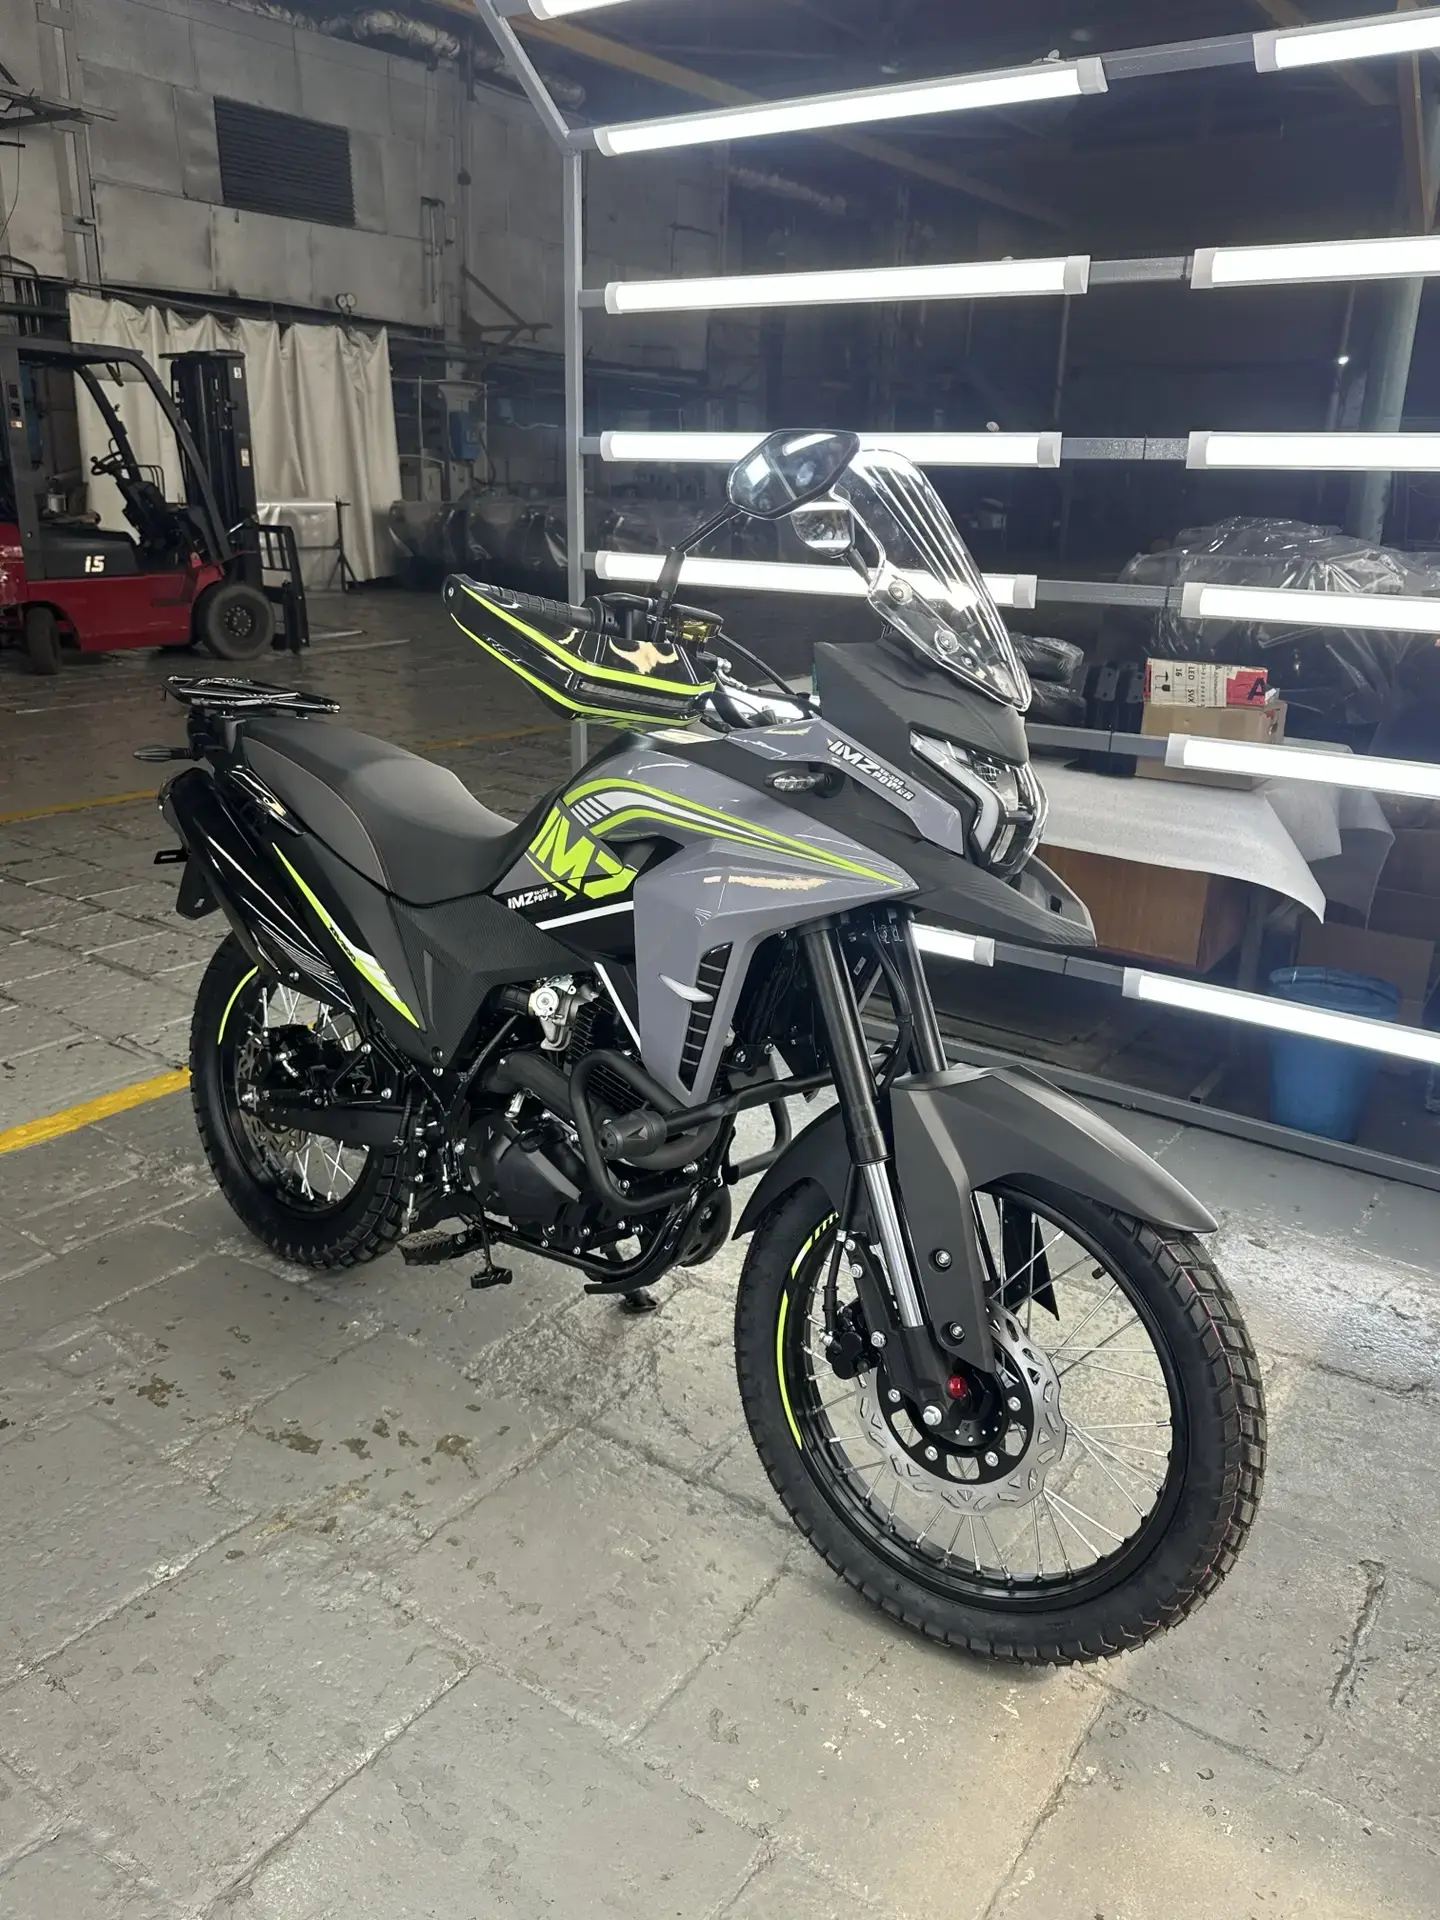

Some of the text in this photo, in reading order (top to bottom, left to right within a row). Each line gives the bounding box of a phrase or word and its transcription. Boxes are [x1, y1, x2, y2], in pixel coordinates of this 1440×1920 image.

[1187, 666, 1195, 704] LED SVX
[828, 740, 881, 774] IMZ
[870, 770, 915, 800] POWER
[507, 891, 535, 909] IMZ
